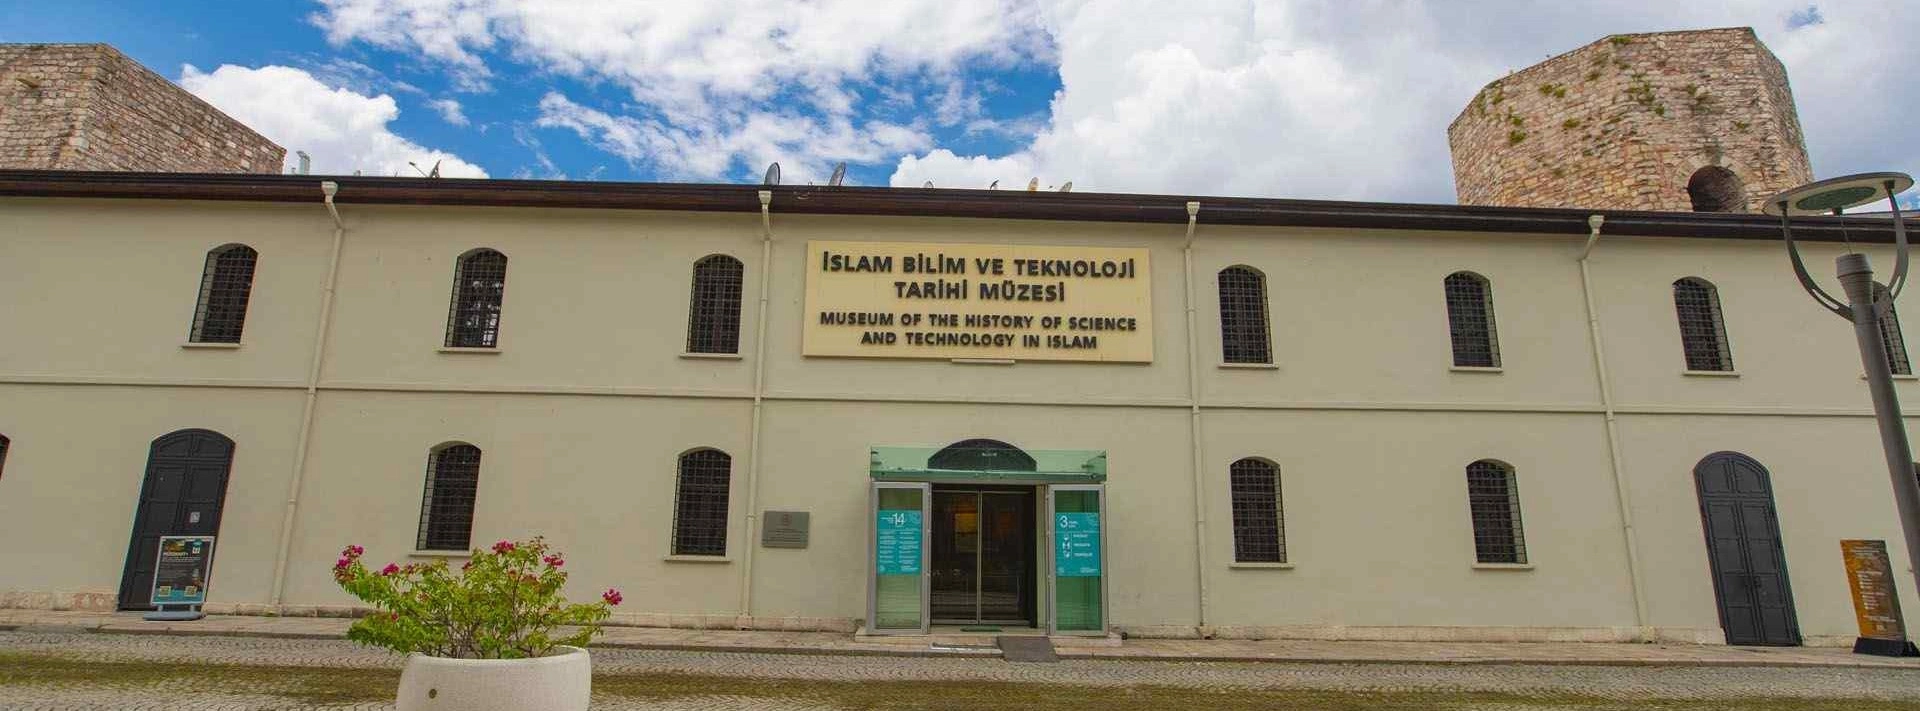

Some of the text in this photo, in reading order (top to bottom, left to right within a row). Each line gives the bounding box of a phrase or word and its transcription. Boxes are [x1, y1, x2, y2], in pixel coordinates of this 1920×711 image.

[823, 251, 1135, 278] İSLAM BİLİM VE TEKNOLOJİ
[895, 279, 1065, 301] TARİHİ MÜZESİ
[821, 312, 1136, 331] MUSEUM OF THE HISTORY OF SCIENCE
[861, 332, 1097, 348] AND TECHNOLOGY IN ISLAM
[892, 512, 905, 526] 14
[1060, 515, 1068, 528] 3
